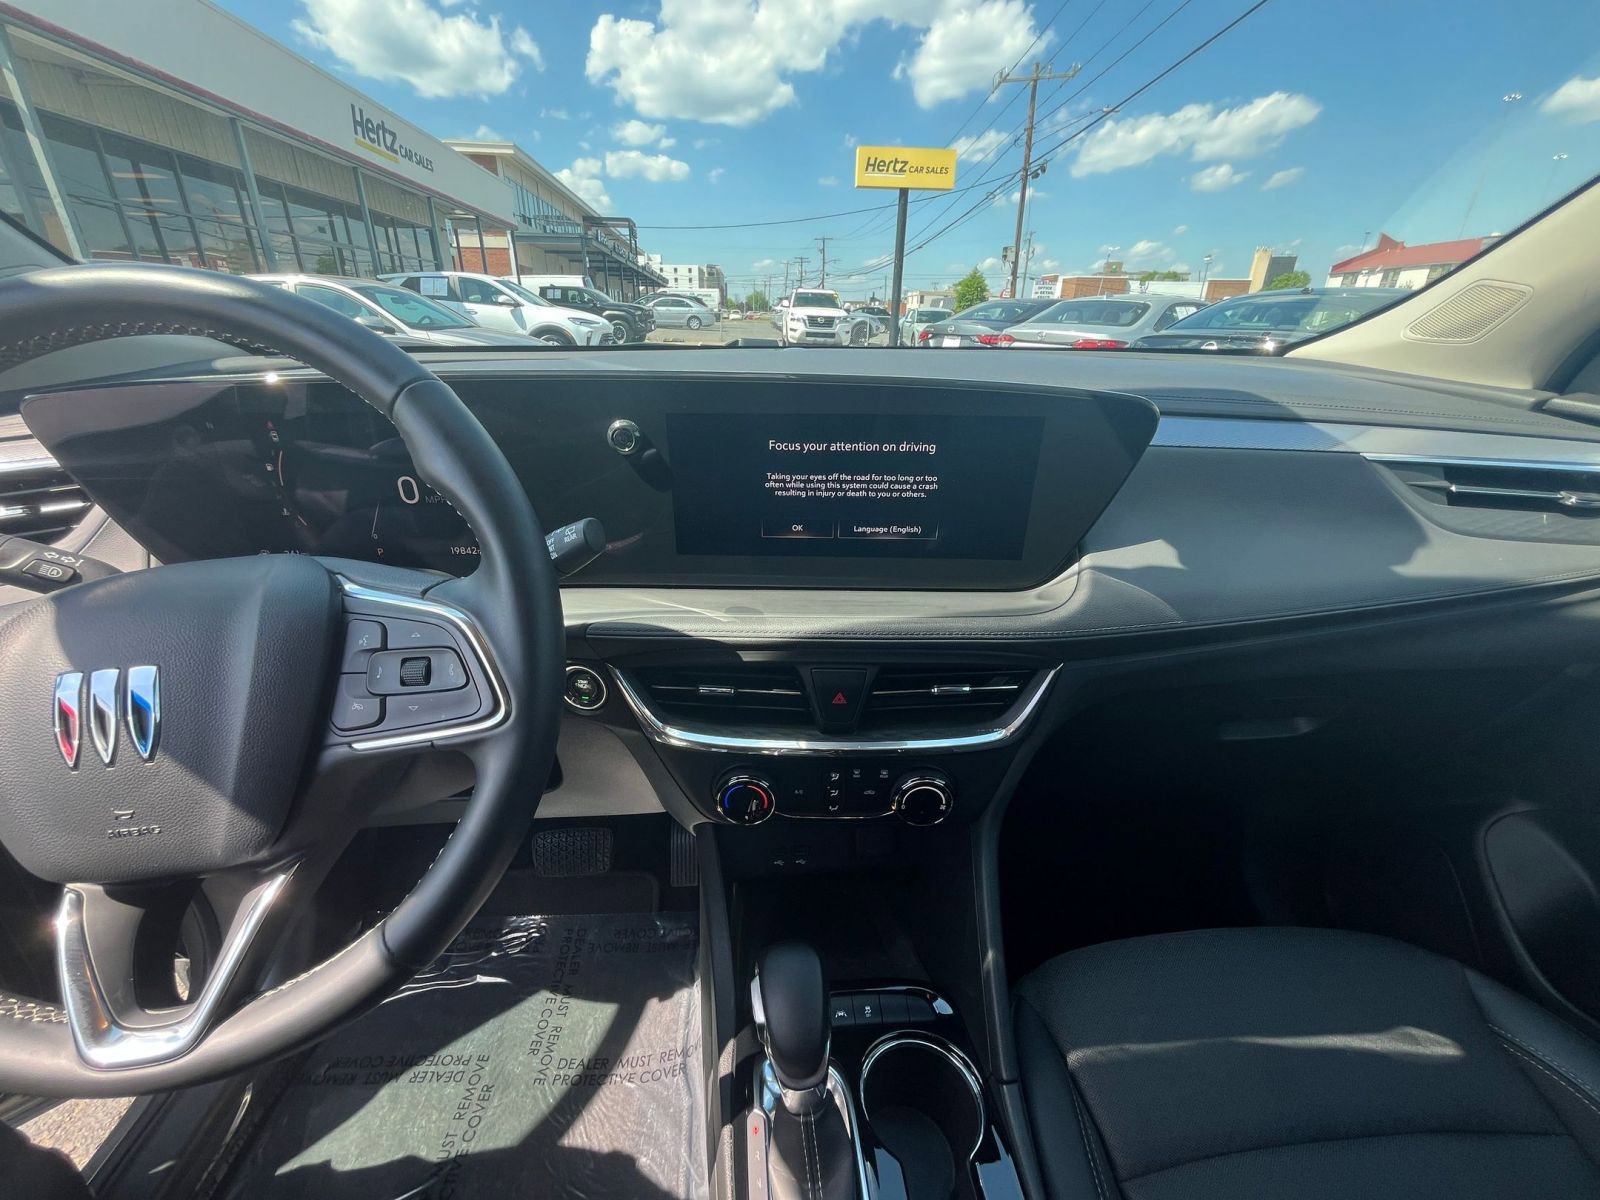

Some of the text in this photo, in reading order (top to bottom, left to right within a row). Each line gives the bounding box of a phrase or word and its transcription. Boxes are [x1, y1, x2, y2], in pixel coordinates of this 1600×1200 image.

[351, 103, 434, 173] Hertz CAR SALES
[865, 156, 950, 175] Hertz CAR SALES
[769, 439, 936, 455] Focus your attention on driving
[766, 473, 790, 481] Taking
[897, 475, 914, 483] long
[397, 476, 419, 504] 0
[774, 490, 806, 498] resulting
[815, 490, 836, 499] injury
[901, 490, 927, 498] others.
[806, 482, 826, 490] using
[842, 483, 868, 491] system
[868, 482, 889, 490] could
[791, 524, 804, 532] OK
[853, 526, 922, 535] Language (English)
[564, 532, 577, 543] REAR
[108, 824, 162, 839] AIRBAG
[528, 928, 574, 1057] PROTECTIVE COVER
[533, 928, 587, 1086] DEALER MUST REMOVE
[336, 1054, 471, 1068] PROTECTIVE COVER
[557, 1057, 610, 1071] DEALER
[617, 1053, 654, 1070] MUST
[409, 1071, 466, 1084] DEALER
[552, 1062, 688, 1087] PROTECTIVE COVER
[452, 1054, 490, 1121] REMOVE
[462, 1083, 495, 1143] COVER
